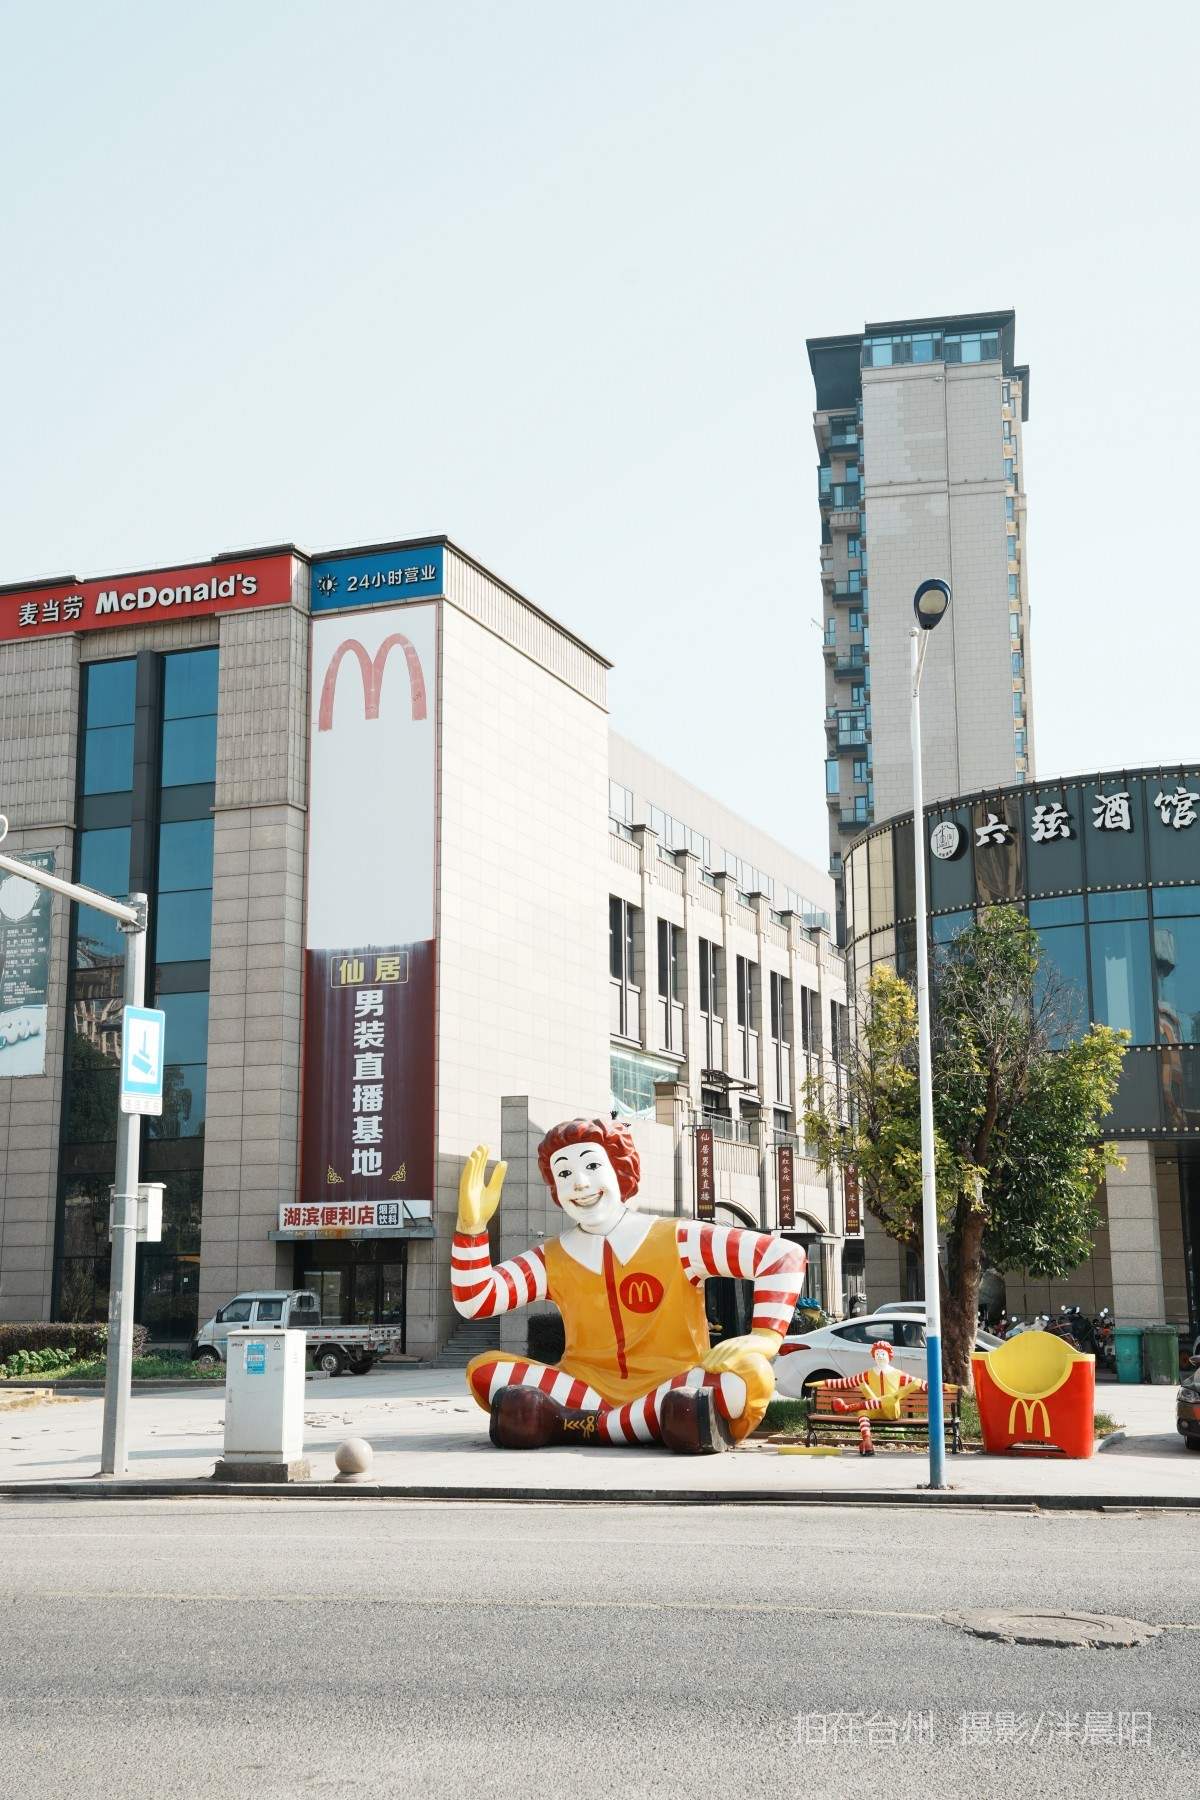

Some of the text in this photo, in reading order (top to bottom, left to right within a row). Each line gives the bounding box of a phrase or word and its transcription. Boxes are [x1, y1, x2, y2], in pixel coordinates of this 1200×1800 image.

[346, 564, 437, 593] 24小时营业
[18, 572, 258, 627] 麦当劳 McDonald's
[975, 786, 1200, 847] 六弦酒馆
[339, 956, 402, 985] 仙居
[352, 989, 385, 1177] 男装直播基地
[283, 1205, 375, 1227] 湖滨便利店
[378, 1204, 398, 1214] 烟酒
[378, 1214, 398, 1225] 饮料
